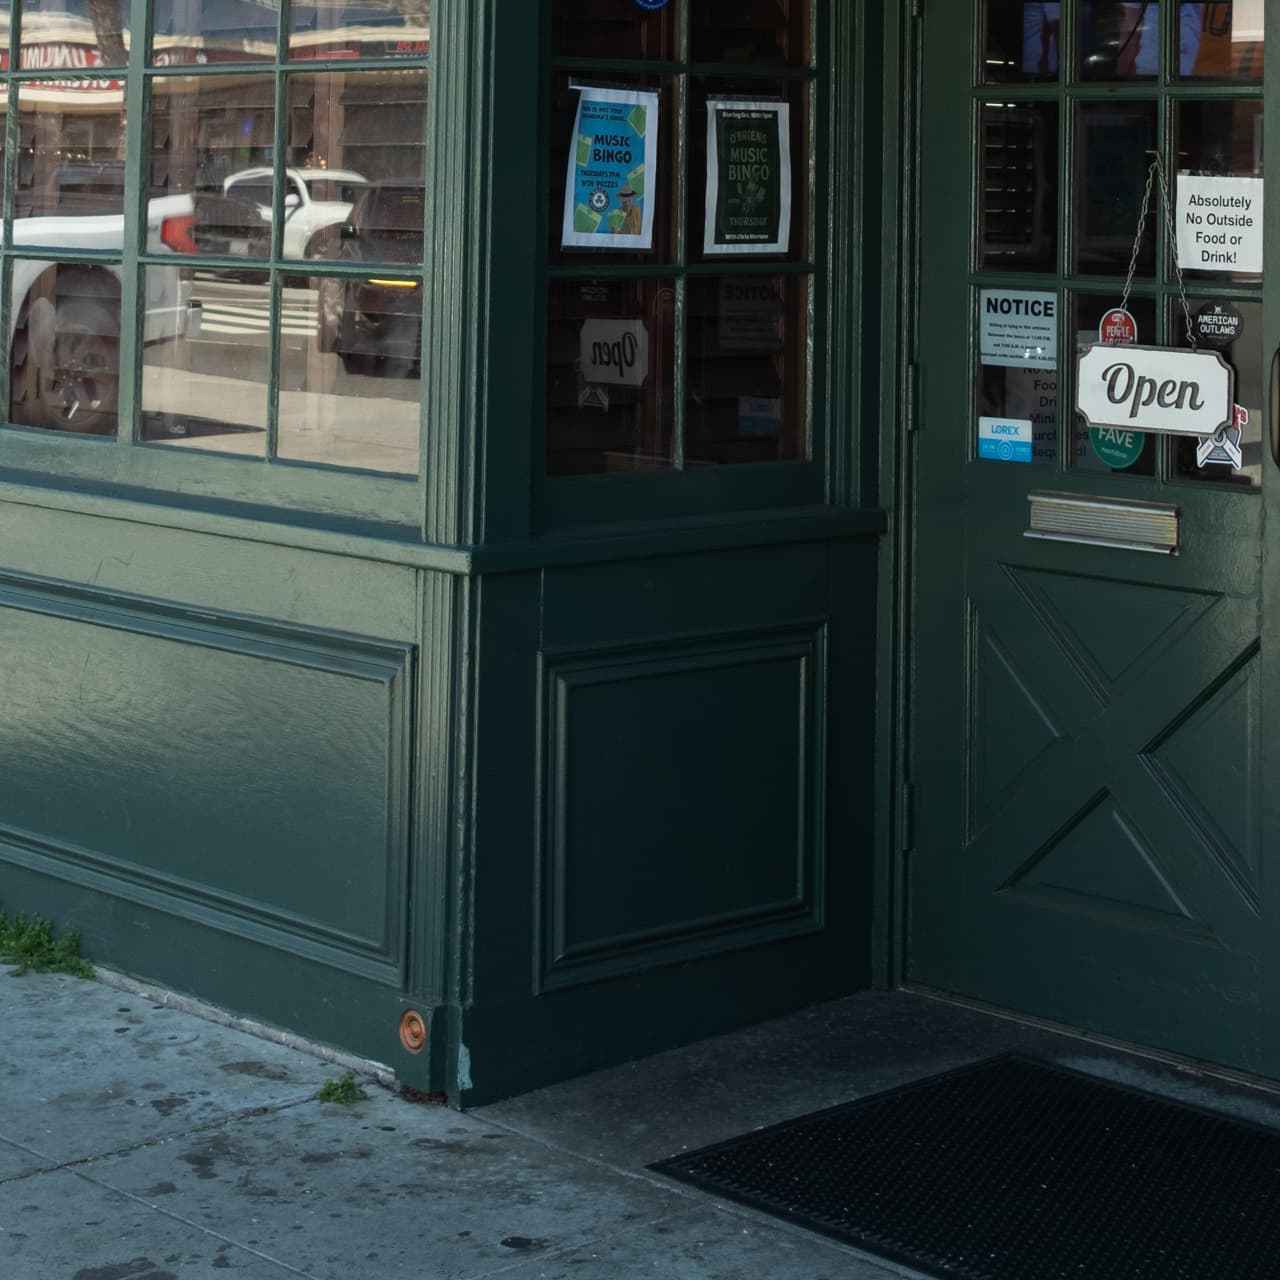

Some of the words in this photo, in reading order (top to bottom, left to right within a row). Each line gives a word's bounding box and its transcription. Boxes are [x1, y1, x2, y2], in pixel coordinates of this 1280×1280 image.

[594, 134, 630, 148] MUSIC
[593, 148, 632, 164] BINGO
[730, 148, 768, 164] MUSIC
[728, 164, 770, 181] BINGO
[1188, 195, 1252, 212] Absolutely
[1185, 213, 1203, 226] No
[1206, 214, 1253, 228] Outside
[1195, 232, 1228, 246] Food
[1230, 235, 1243, 246] or
[1201, 250, 1237, 265] Drink!
[985, 296, 1055, 318] NOTICE
[1197, 314, 1239, 326] AMERICAN
[1200, 324, 1236, 336] OUTLAWS
[1102, 362, 1205, 418] Open
[991, 424, 1020, 436] LOREX
[1098, 427, 1135, 449] FAVE
